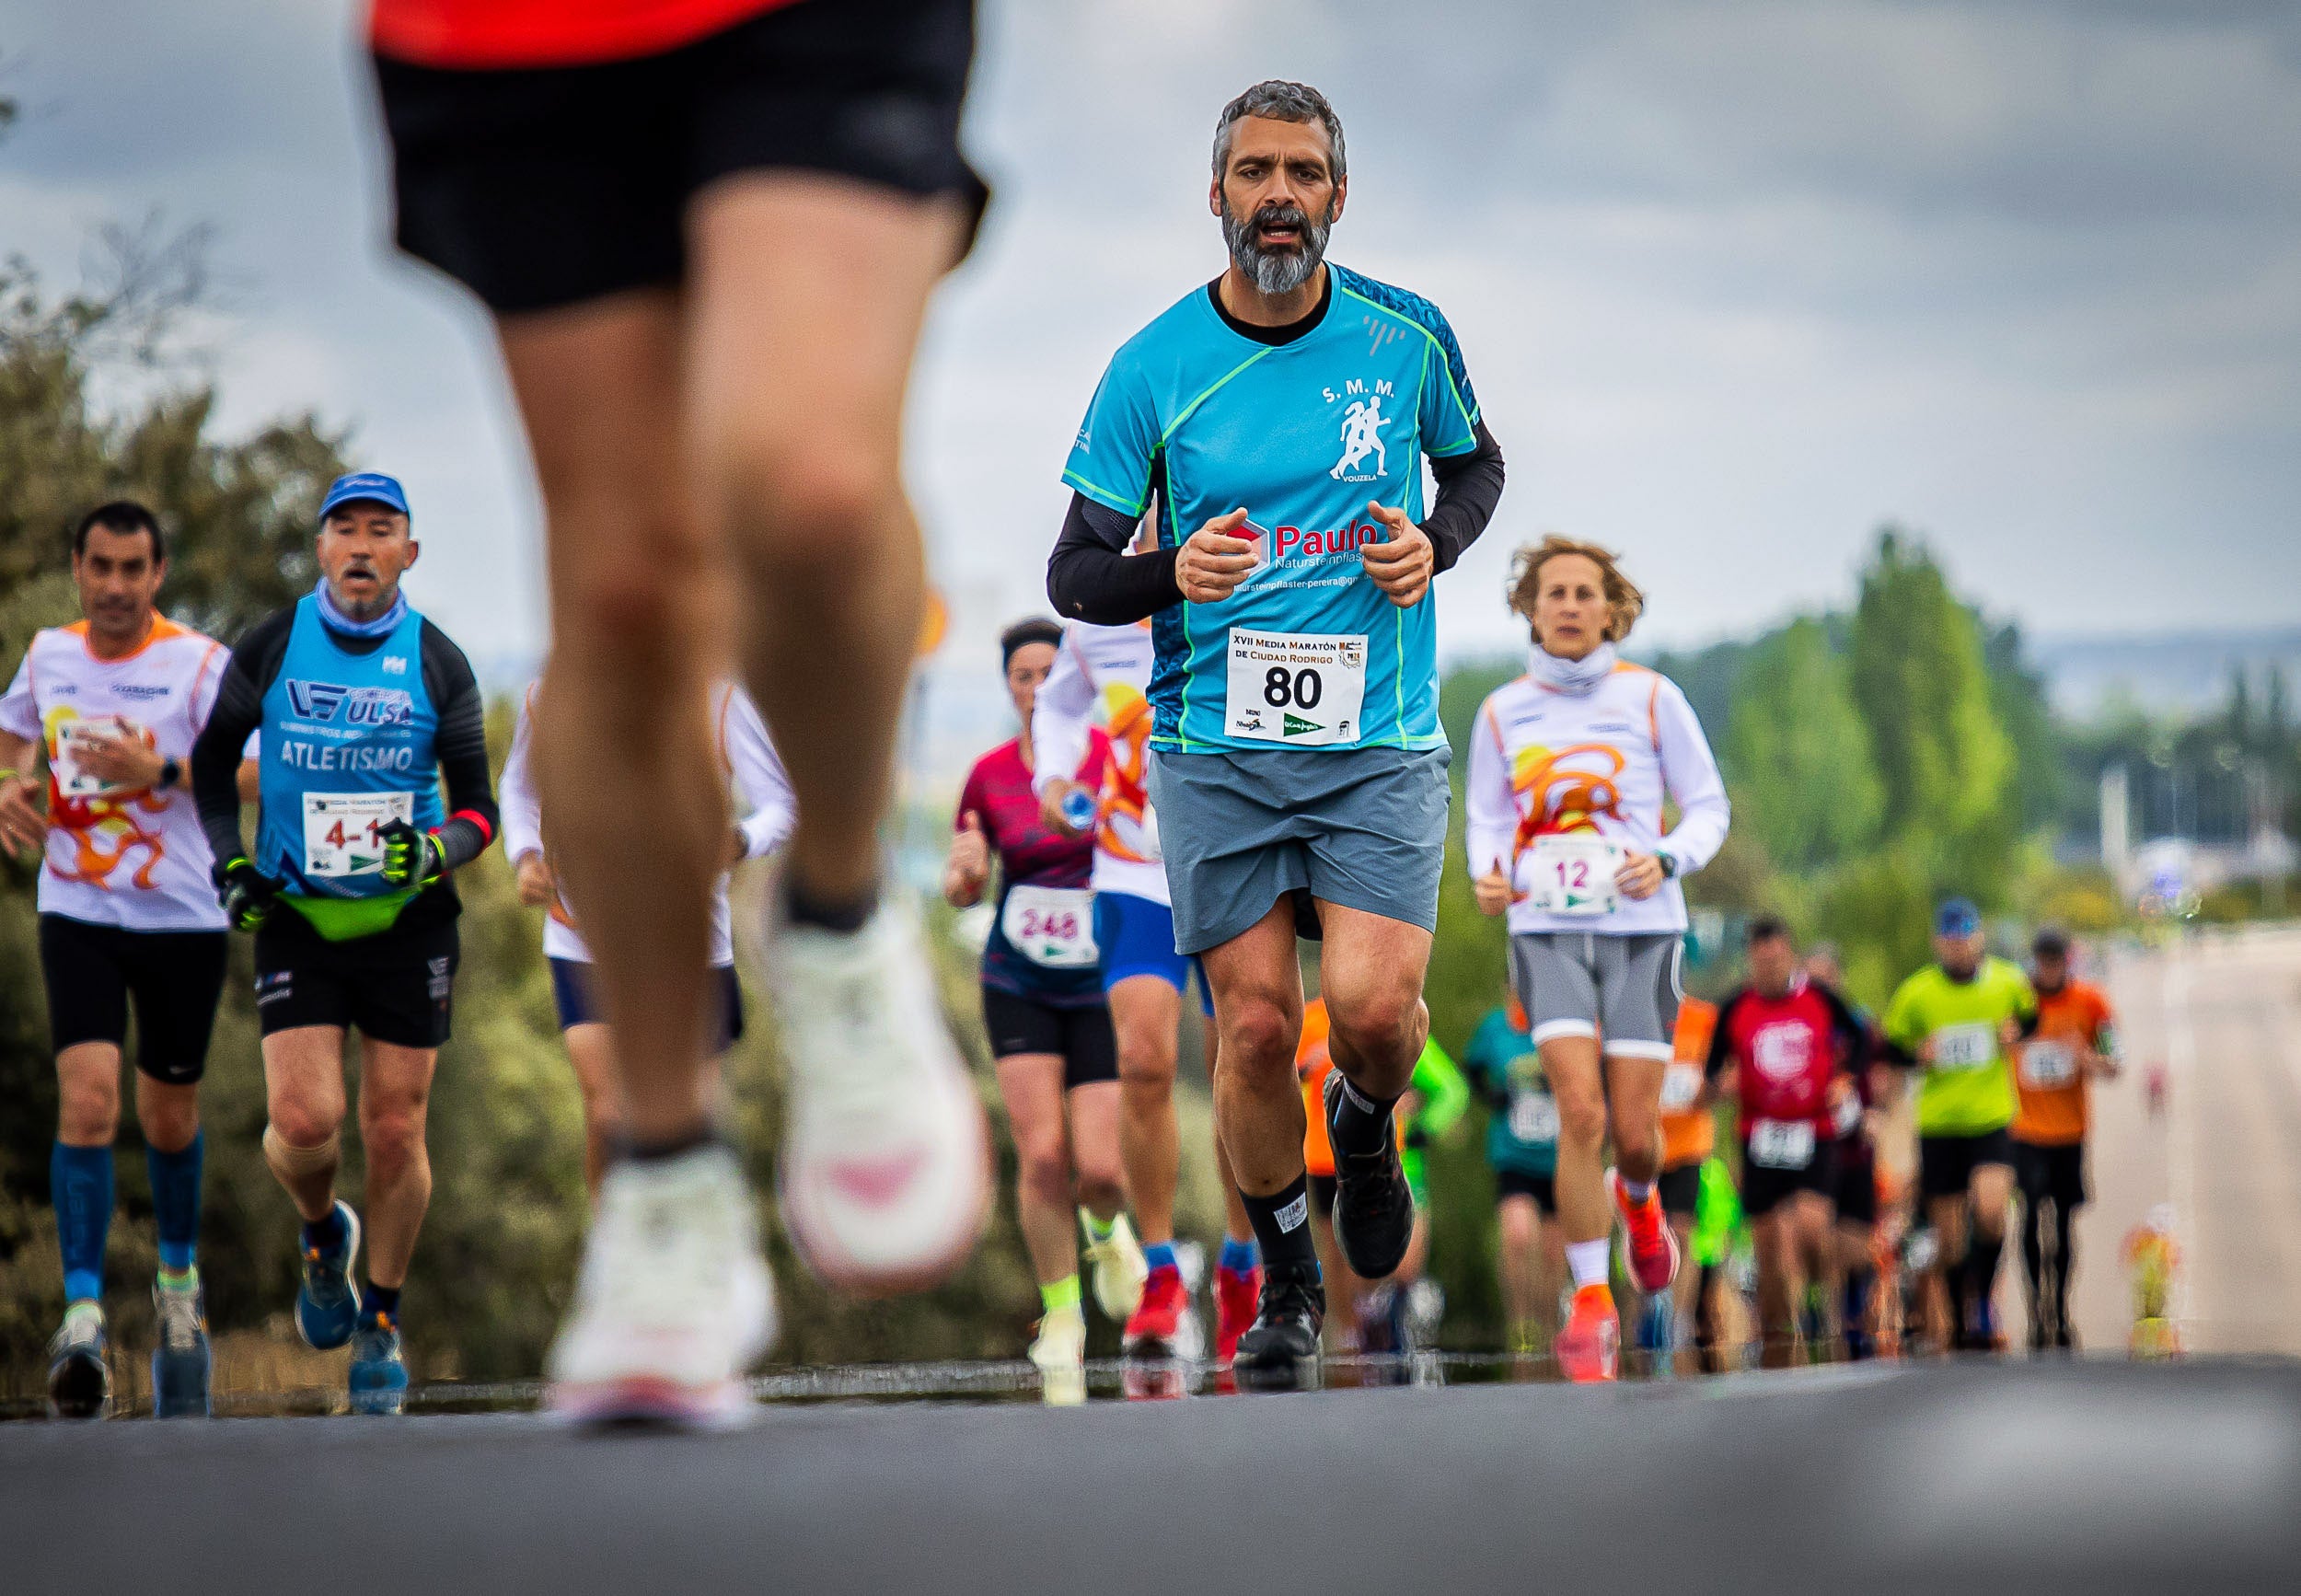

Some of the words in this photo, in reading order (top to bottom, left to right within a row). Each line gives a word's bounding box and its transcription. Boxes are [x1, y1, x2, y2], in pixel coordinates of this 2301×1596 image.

[1322, 387, 1341, 403] S.
[1345, 378, 1370, 395] M.
[1375, 378, 1394, 399] M.
[1343, 474, 1378, 482] VOUZELA
[1275, 519, 1378, 558] Paulo
[1275, 551, 1363, 569] Natursteinpflas
[1233, 635, 1254, 646] XVII
[1256, 639, 1287, 650] MEDIA
[1289, 639, 1336, 651] MARATÓN
[1235, 650, 1248, 659] DE
[1250, 651, 1287, 663] CIUDAD
[1289, 654, 1333, 665] RODRIGO
[1264, 666, 1323, 710] 80
[281, 740, 413, 771] ATLETISMO
[1555, 860, 1589, 888] 12
[1022, 908, 1079, 939] 248
